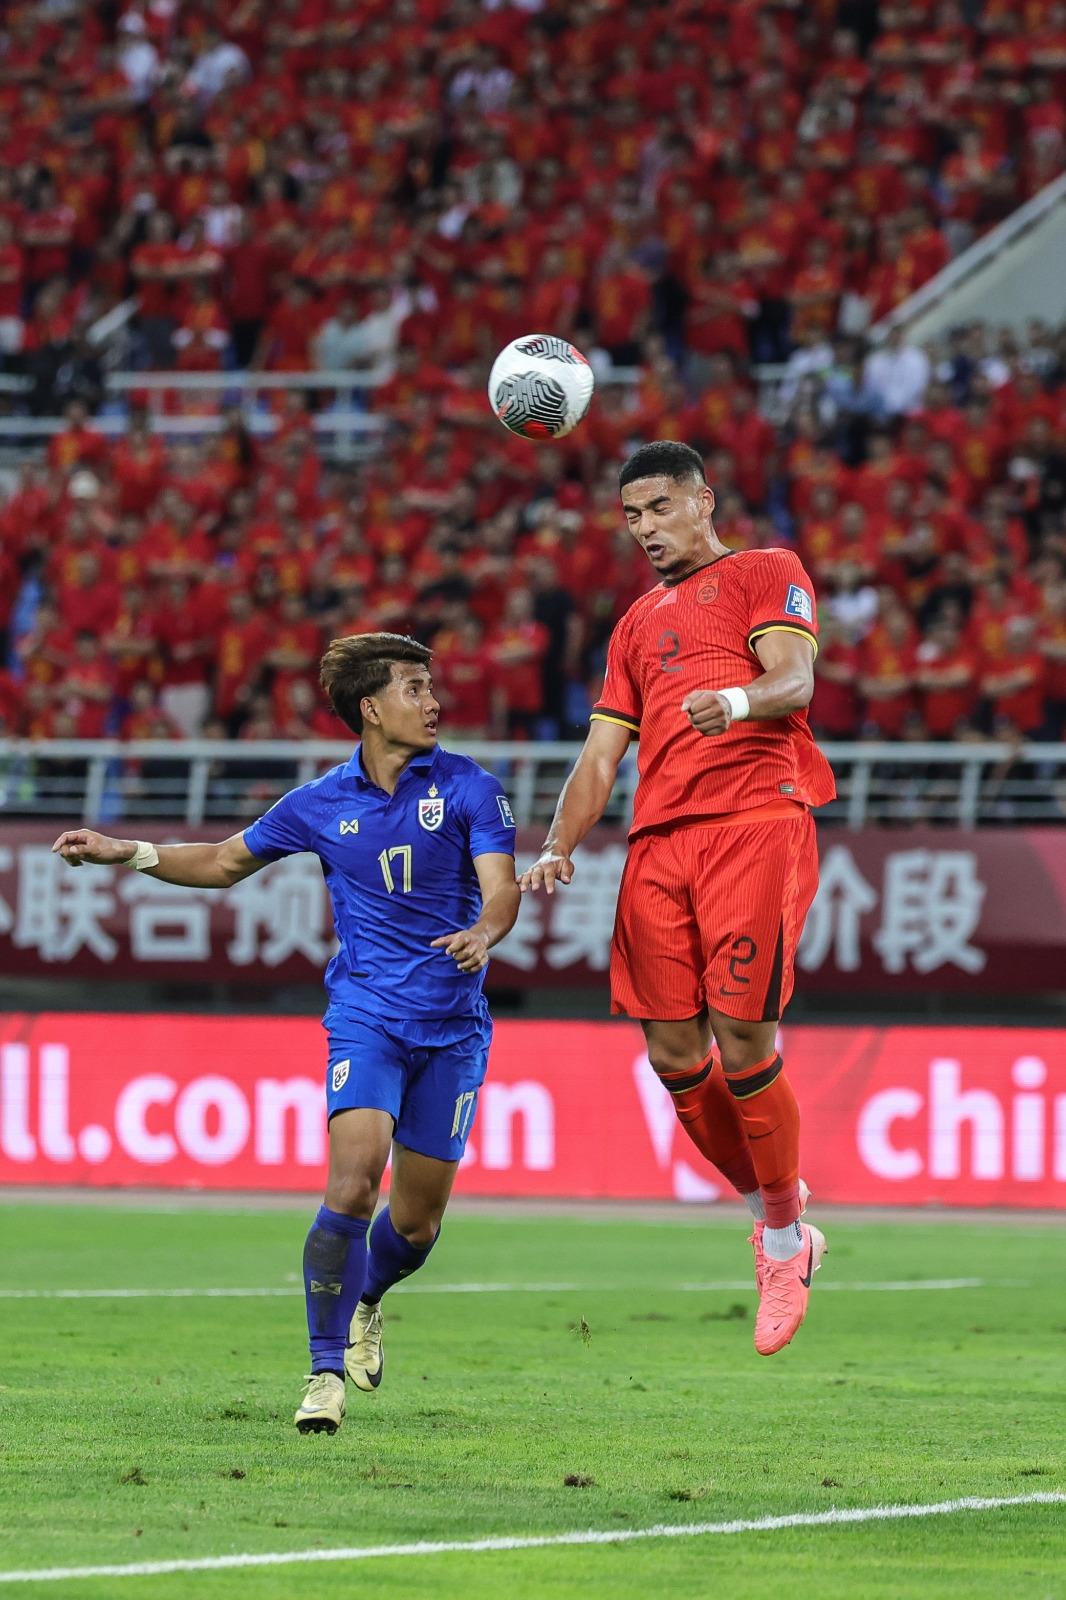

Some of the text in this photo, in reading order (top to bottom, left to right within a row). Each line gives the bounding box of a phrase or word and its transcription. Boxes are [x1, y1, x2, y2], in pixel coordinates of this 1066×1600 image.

[657, 629, 684, 673] 2
[377, 844, 412, 895] 17
[730, 937, 757, 983] 2
[450, 1092, 475, 1138] 17
[857, 1056, 1066, 1181] chi
